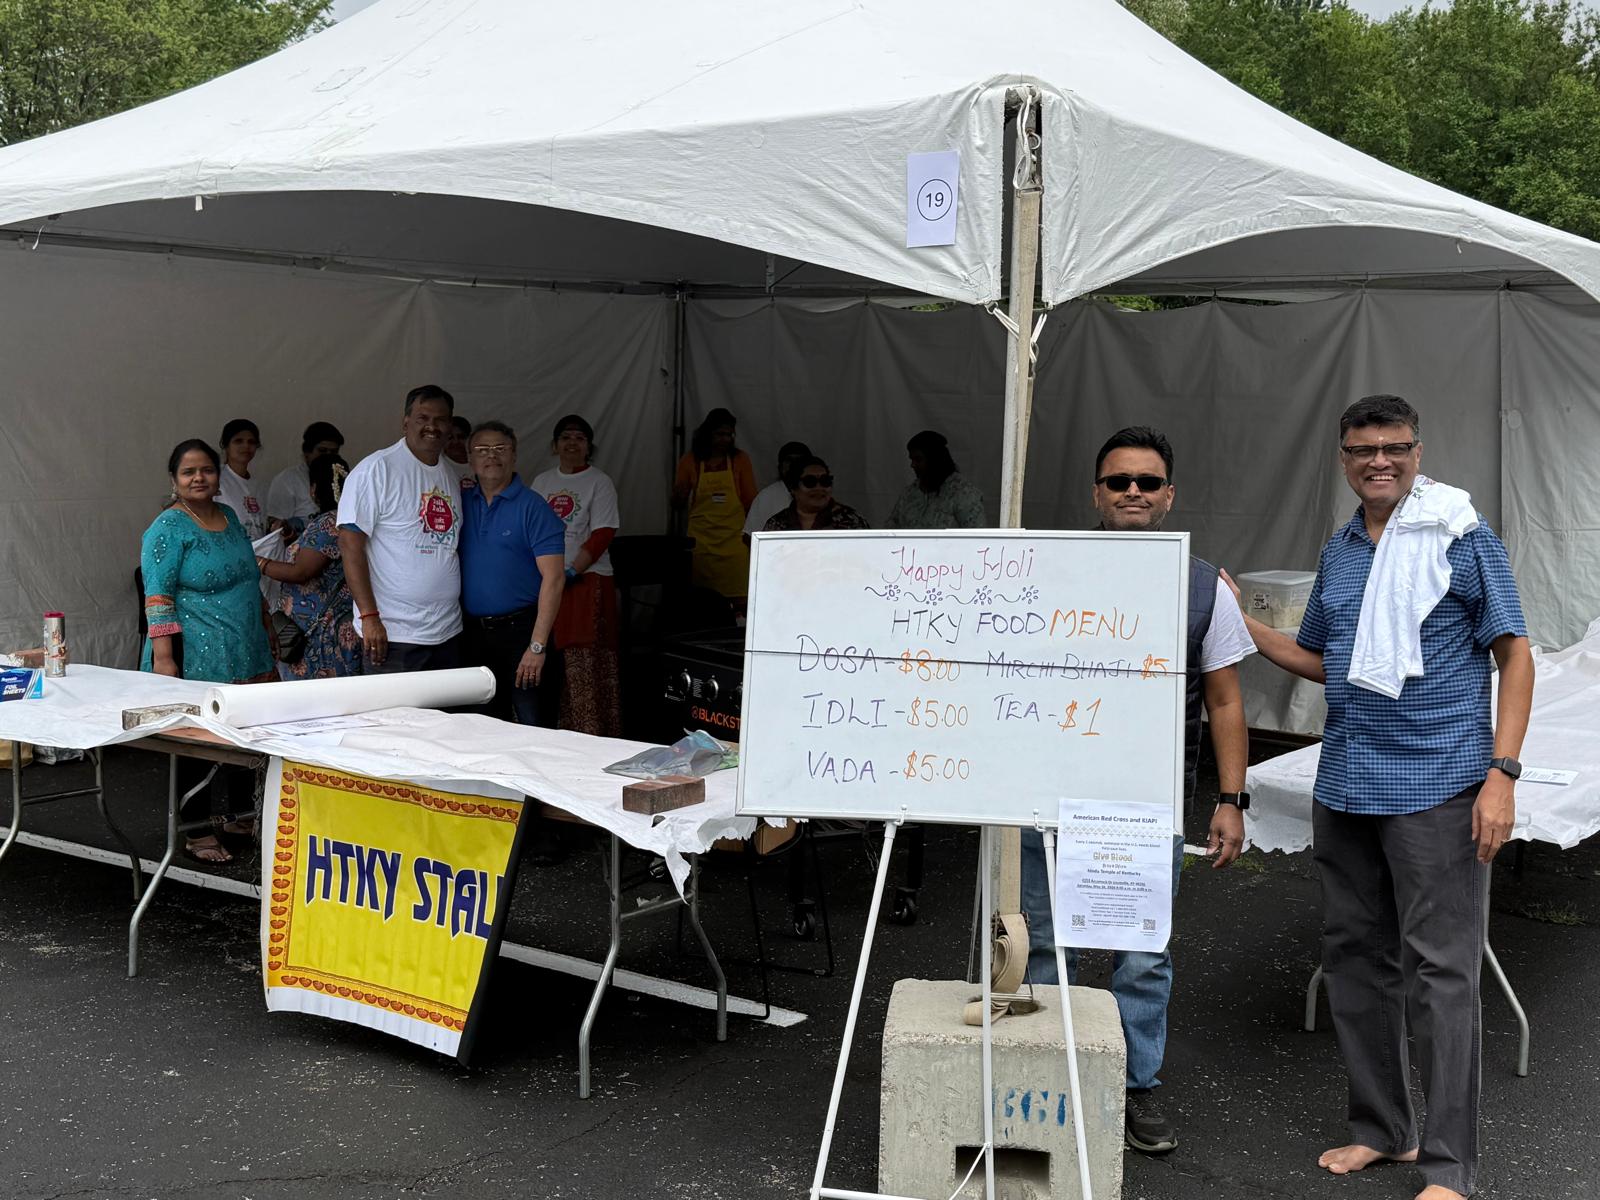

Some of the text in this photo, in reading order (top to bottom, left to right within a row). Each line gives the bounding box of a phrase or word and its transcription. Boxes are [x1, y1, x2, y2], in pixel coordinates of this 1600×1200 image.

[926, 191, 945, 209] 19
[881, 545, 1034, 591] Happy Holi
[890, 606, 1140, 645] HTKY FOOD MENU
[1073, 814, 1100, 822] American
[305, 834, 402, 922] HTKY
